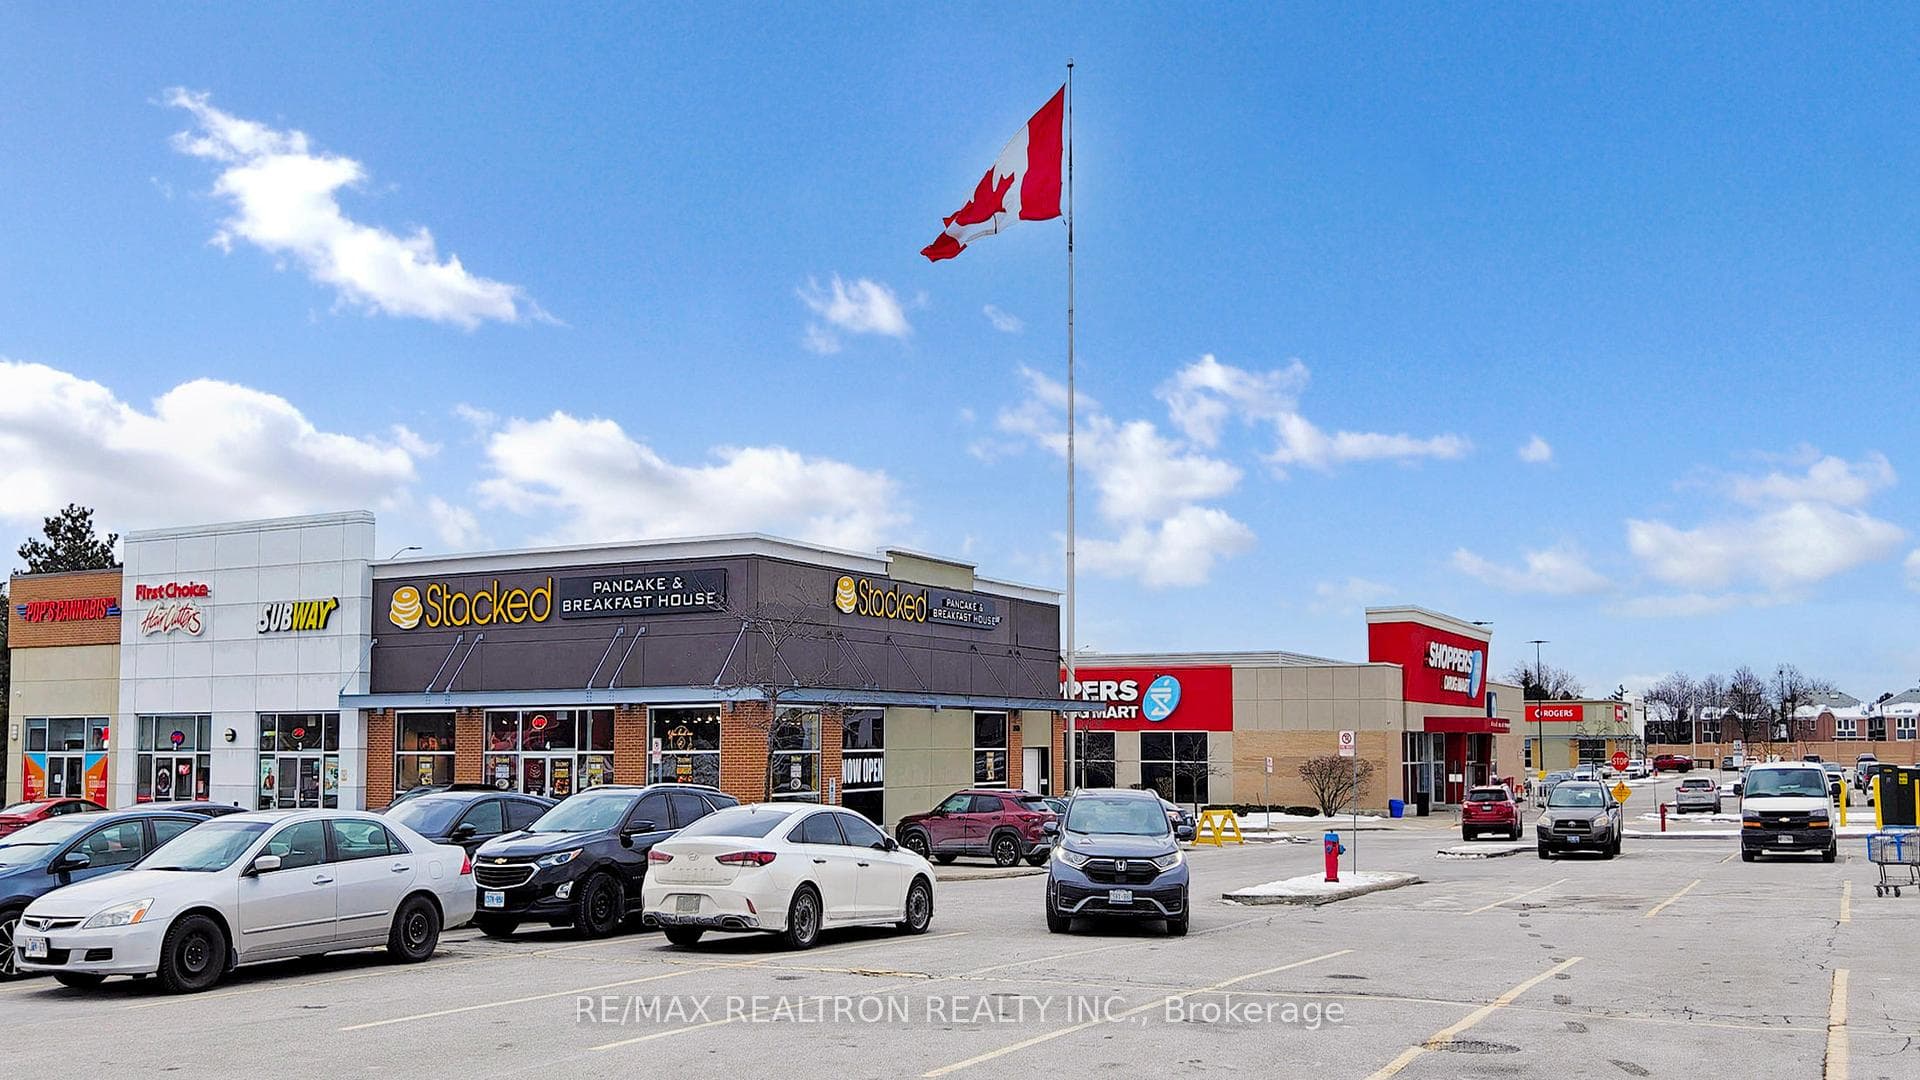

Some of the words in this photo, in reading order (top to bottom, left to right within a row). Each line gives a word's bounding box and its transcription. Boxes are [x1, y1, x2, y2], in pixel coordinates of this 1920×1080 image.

[136, 584, 165, 601] First
[165, 581, 209, 599] Choice
[593, 577, 666, 594] PANCAKE
[672, 577, 684, 589] &
[26, 600, 56, 623] POP'S
[56, 598, 107, 622] CANNABIS
[425, 577, 552, 628] Stacked
[562, 596, 652, 613] BREAKFAST
[658, 592, 716, 607] HOUSE
[859, 578, 928, 624] Stacked
[945, 598, 977, 612] PANCAKE
[978, 603, 985, 612] &
[257, 598, 338, 633] SUBWAY
[932, 609, 972, 623] BREAKFAST
[973, 614, 996, 626] HOUSE
[1429, 641, 1473, 673] SHOPPERS
[1060, 680, 1139, 702] PERS
[1544, 708, 1574, 718] ROGERS
[842, 759, 862, 784] NOW
[862, 758, 884, 783] OPEN
[1612, 757, 1629, 766] STOP
